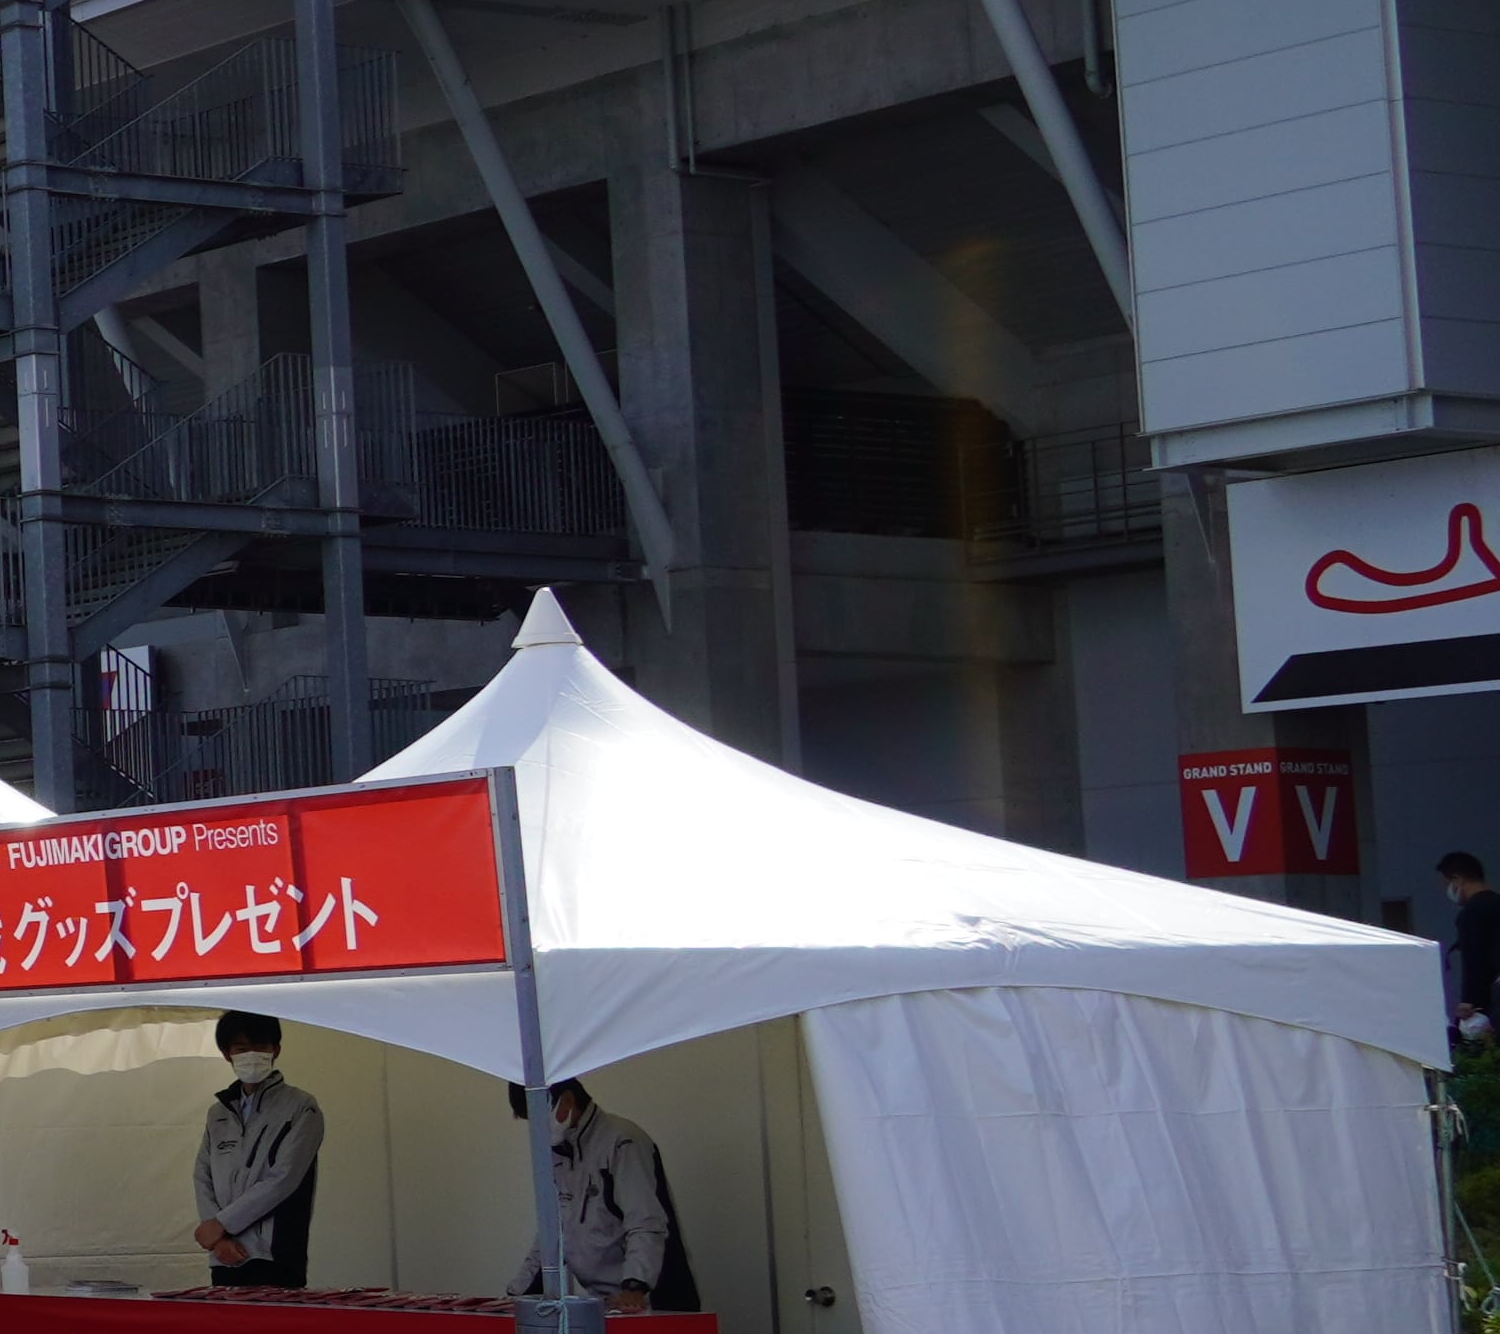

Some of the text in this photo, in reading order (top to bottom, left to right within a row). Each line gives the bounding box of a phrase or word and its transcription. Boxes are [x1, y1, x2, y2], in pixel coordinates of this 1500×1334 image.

[1183, 762, 1272, 780] GRAND STAND
[1279, 761, 1349, 775] GRAND STAND
[194, 818, 278, 853] Presents
[1201, 786, 1257, 862] V
[1295, 785, 1338, 860] V
